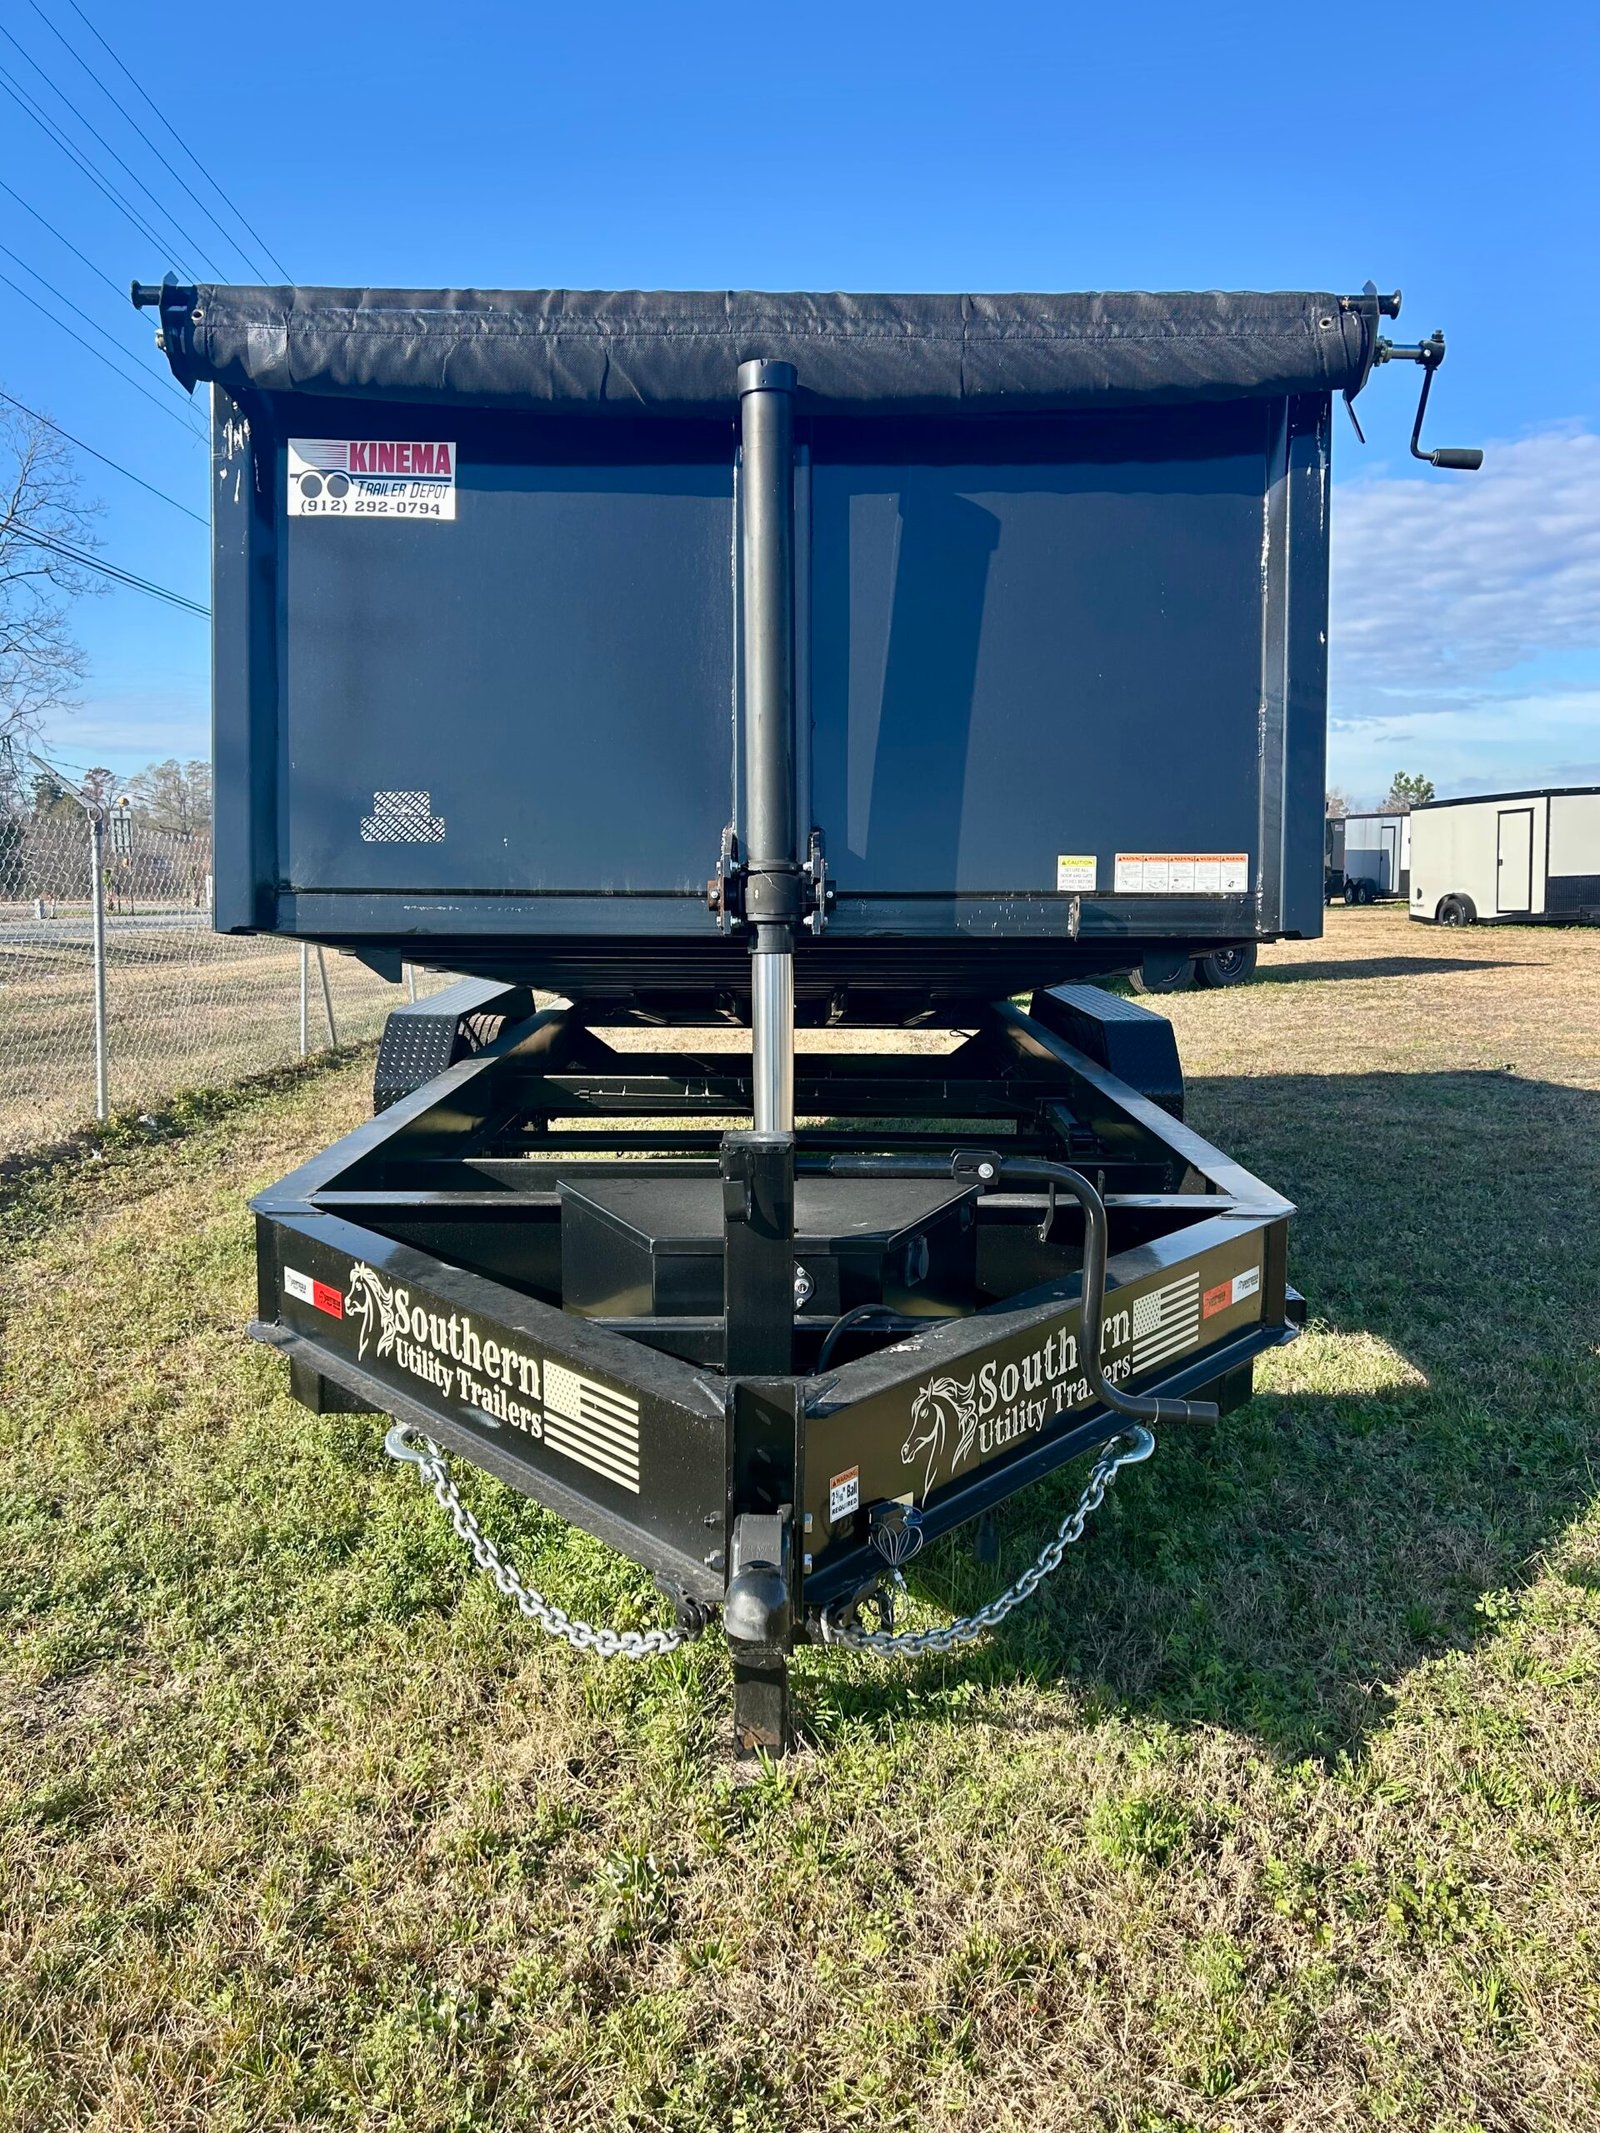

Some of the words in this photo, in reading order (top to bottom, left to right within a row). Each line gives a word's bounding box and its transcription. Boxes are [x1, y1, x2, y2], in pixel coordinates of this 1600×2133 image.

[349, 442, 452, 474] KINEMA
[357, 480, 407, 497] TRAILER
[409, 481, 450, 499] DEPOT
[301, 500, 348, 514] (912)
[354, 501, 440, 515] 292-0794
[394, 1288, 543, 1400] Southern
[978, 1310, 1131, 1417] Southrn
[395, 1336, 454, 1398] Utility
[456, 1368, 544, 1440] Trailers
[978, 1397, 1048, 1454] Utility
[1052, 1354, 1131, 1415] Traers
[836, 1470, 857, 1483] WARNING
[846, 1481, 858, 1498] Ball
[831, 1497, 858, 1515] REQUIRED
